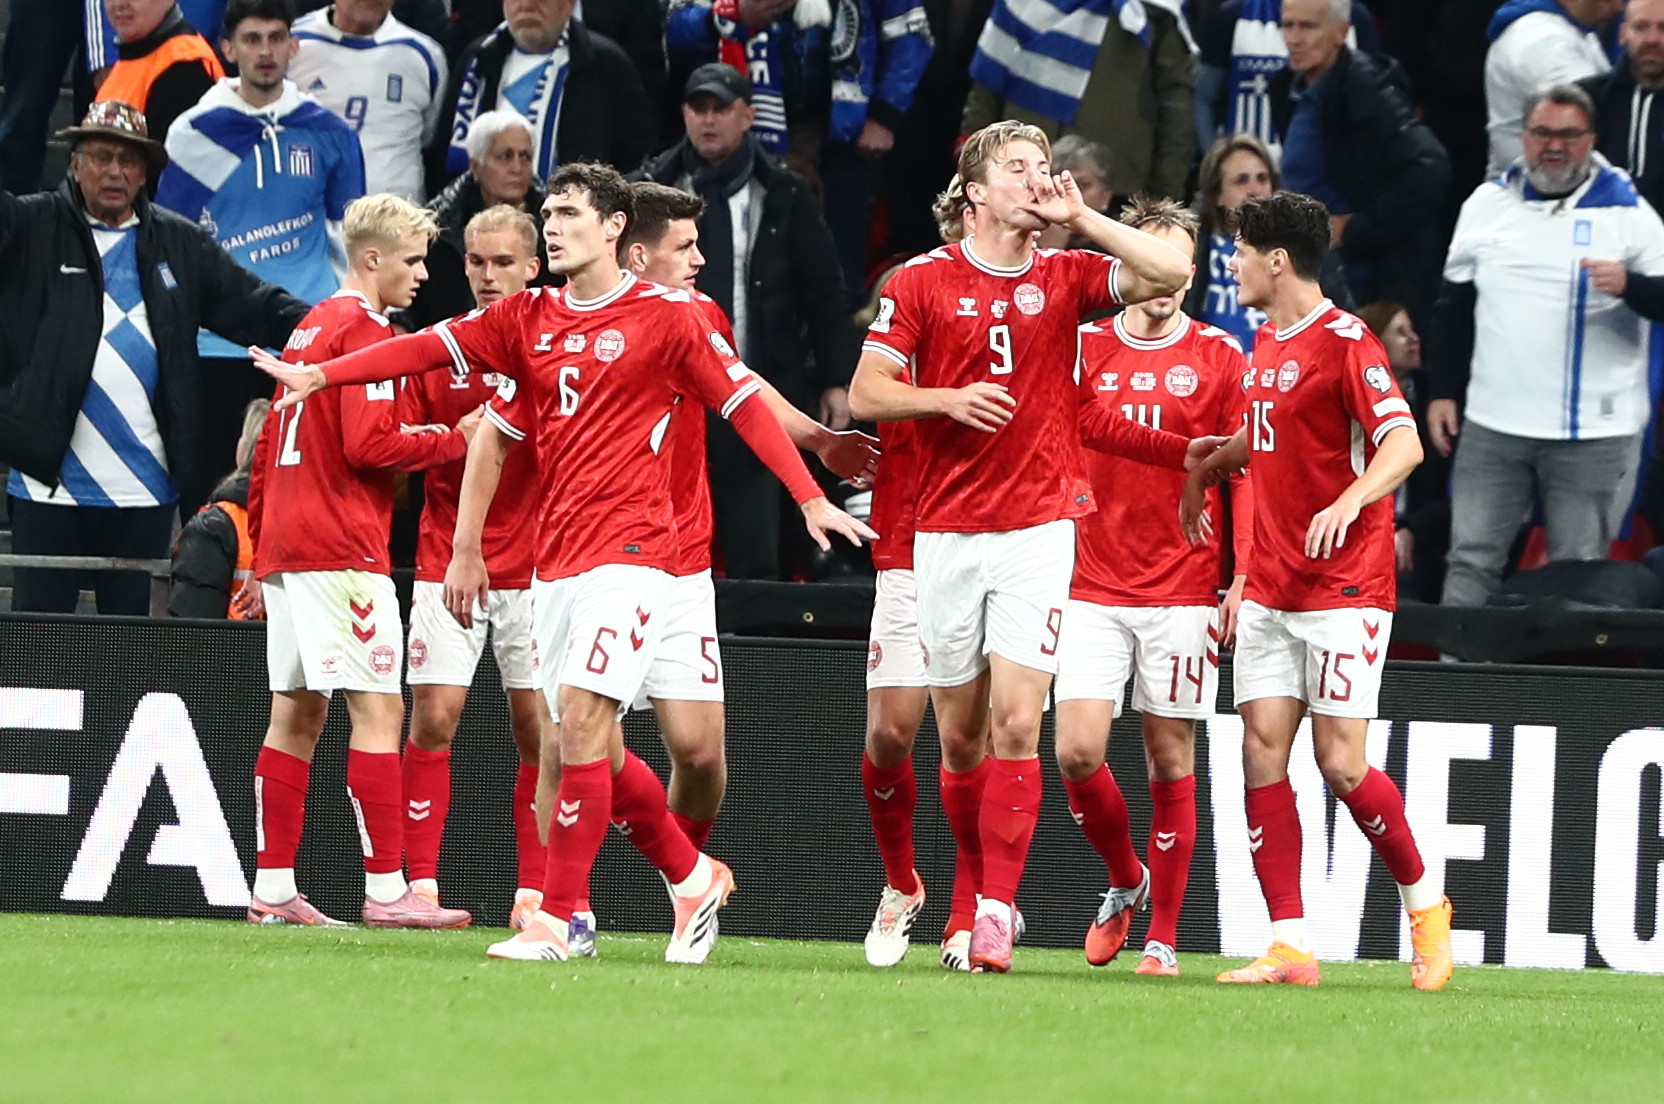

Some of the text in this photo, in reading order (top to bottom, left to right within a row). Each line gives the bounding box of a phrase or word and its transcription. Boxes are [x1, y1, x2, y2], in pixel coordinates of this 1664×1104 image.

[345, 96, 368, 133] 9
[989, 325, 1013, 375] 9
[559, 366, 580, 416] 6
[1252, 400, 1276, 452] 15
[586, 626, 618, 675] 6
[1040, 608, 1063, 656] 9
[701, 636, 718, 684] 5
[1169, 655, 1204, 704] 14
[1318, 650, 1355, 702] 15
